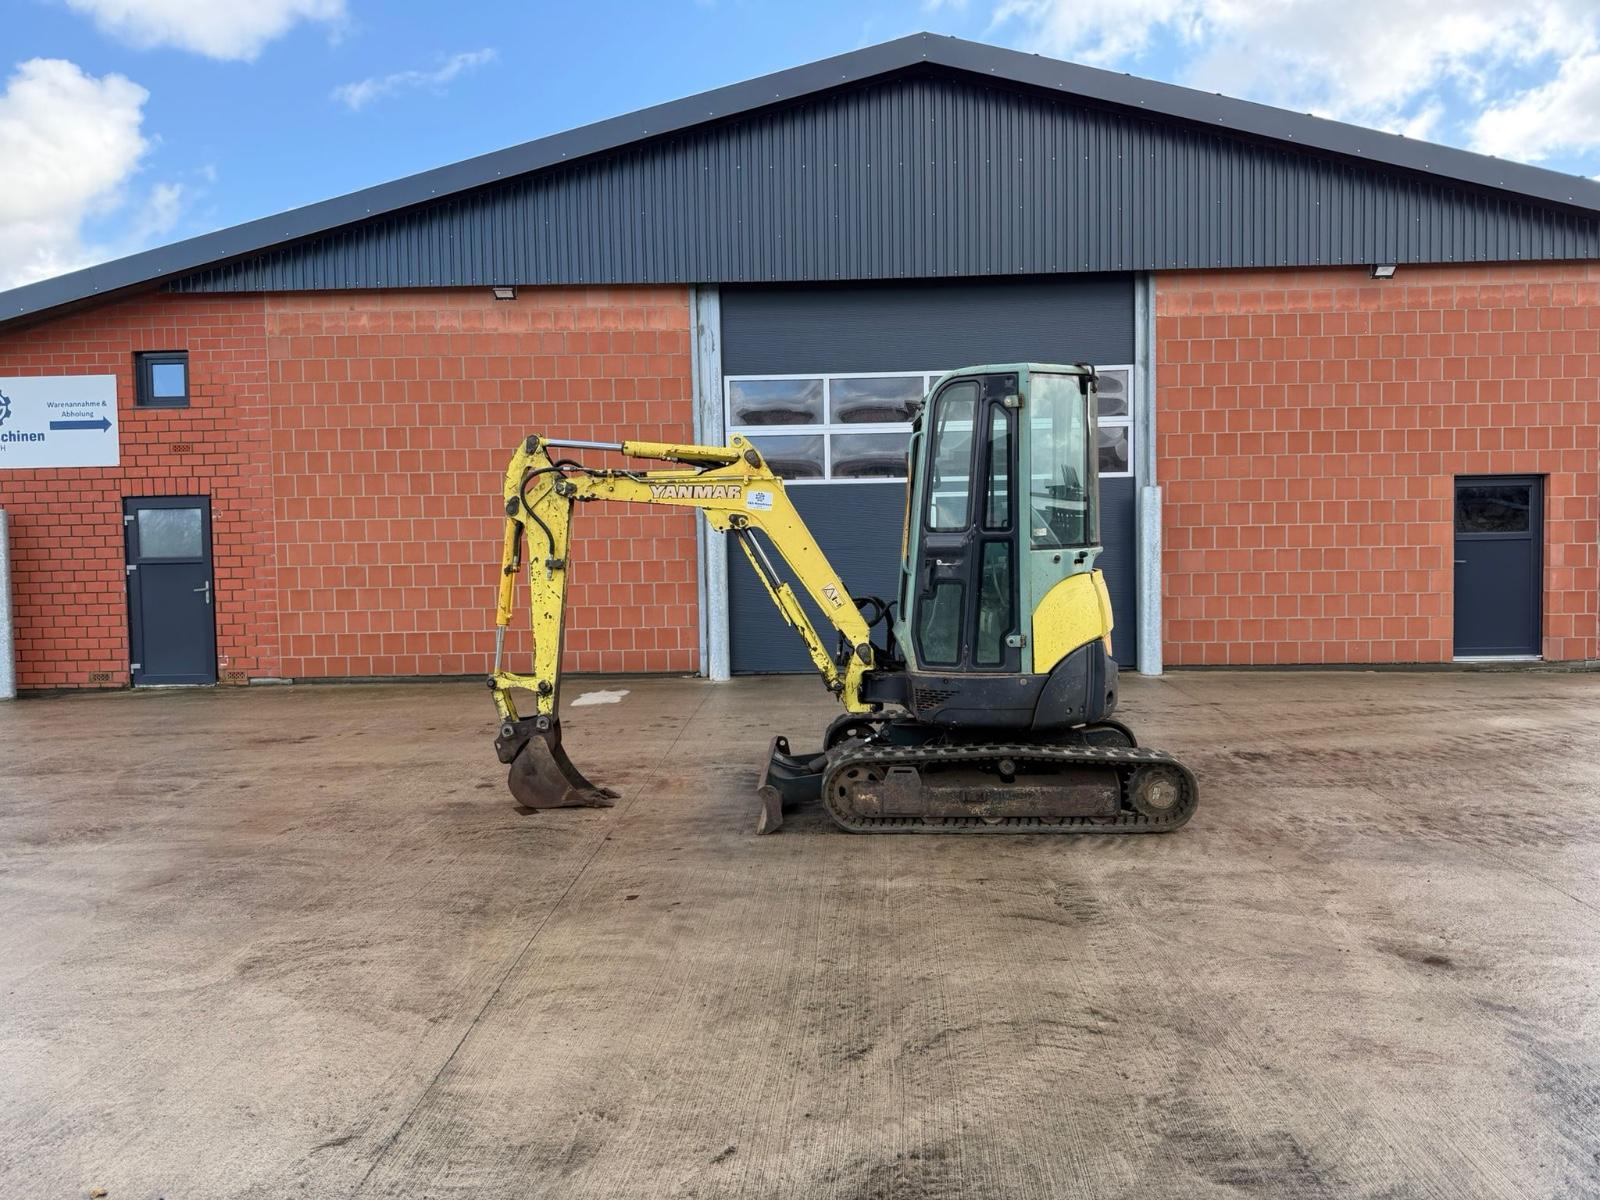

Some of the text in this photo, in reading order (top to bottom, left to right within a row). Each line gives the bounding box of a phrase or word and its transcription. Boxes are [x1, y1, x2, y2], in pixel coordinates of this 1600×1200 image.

[47, 400, 100, 408] Warenannahme
[61, 410, 94, 418] Abholung
[650, 485, 742, 499] YANMAR
